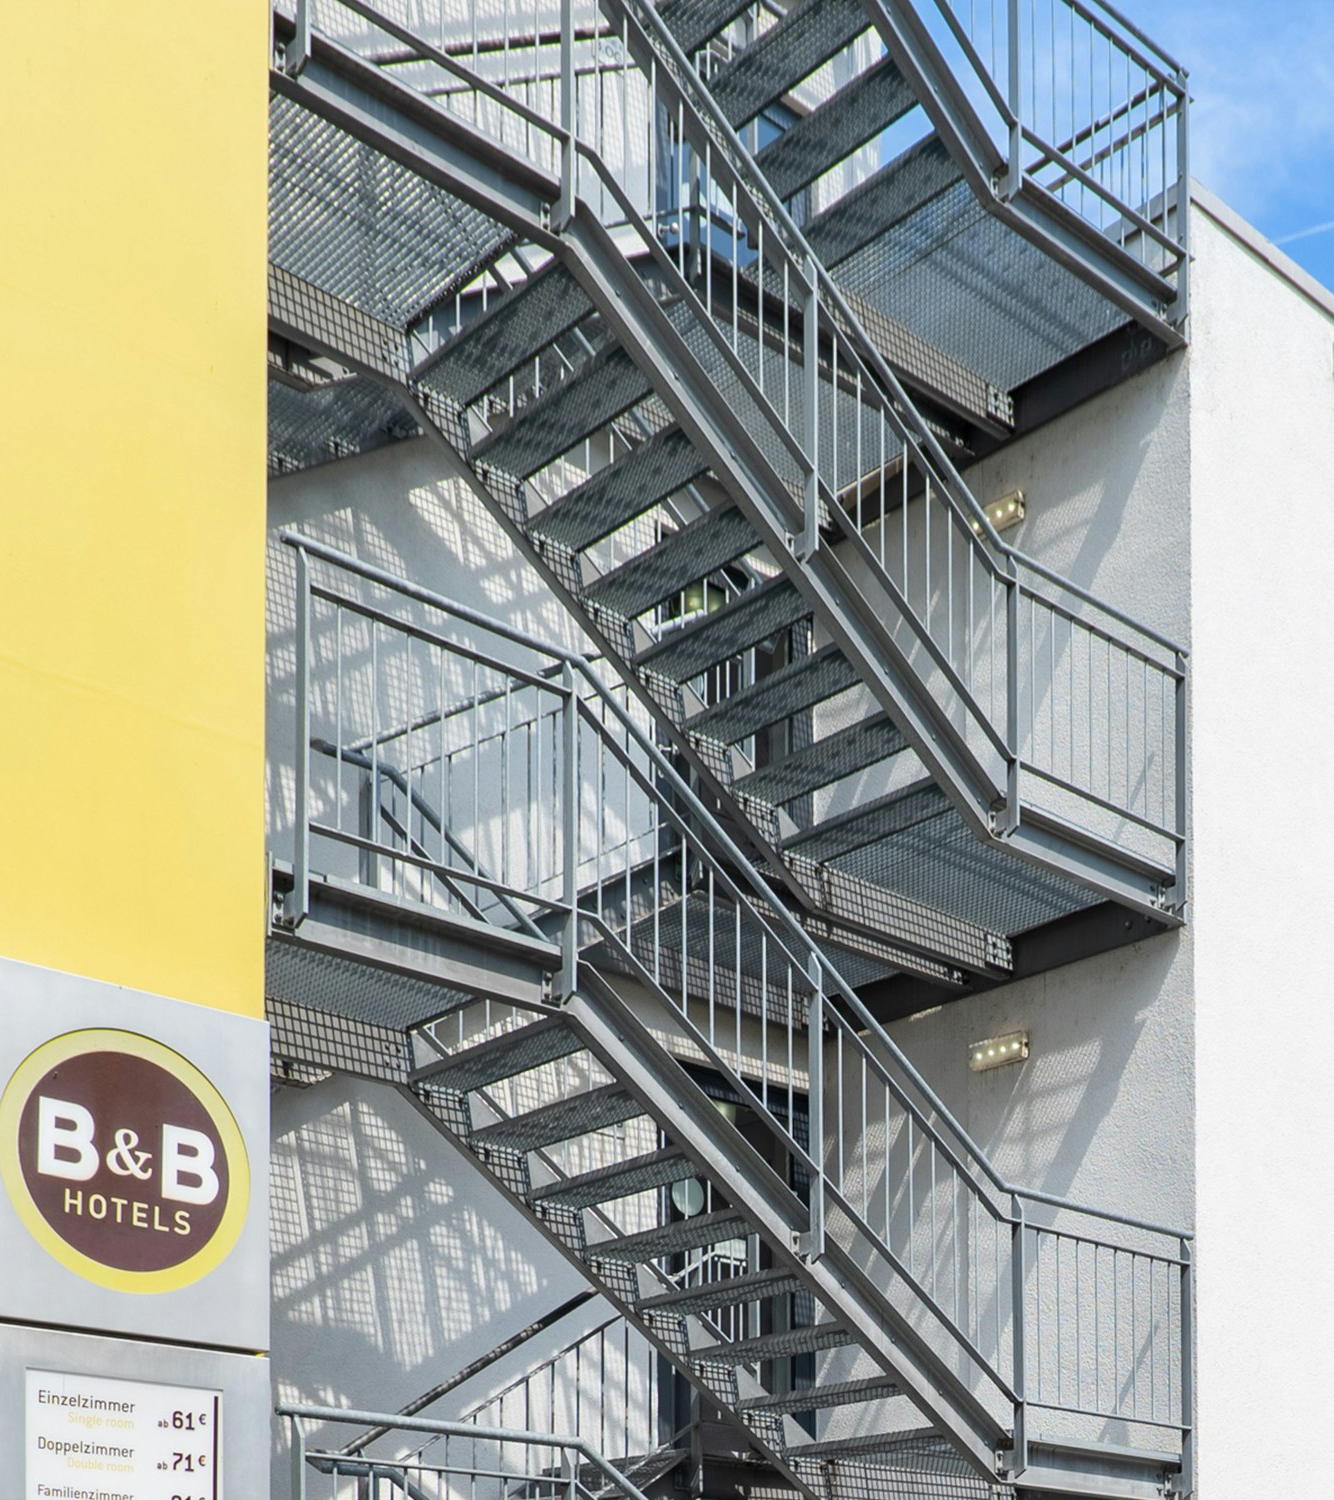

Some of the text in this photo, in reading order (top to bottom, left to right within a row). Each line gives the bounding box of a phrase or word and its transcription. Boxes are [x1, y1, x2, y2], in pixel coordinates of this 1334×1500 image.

[37, 1095, 219, 1206] B&B
[64, 1188, 191, 1236] HOTELS
[38, 1389, 135, 1413] Einzelzimmer
[68, 1411, 134, 1429] Single room
[157, 1419, 169, 1428] ab
[172, 1410, 195, 1431] 61
[38, 1436, 134, 1458] Doppelzimmer
[67, 1456, 134, 1473] Double room
[157, 1461, 168, 1470] ab
[172, 1452, 195, 1472] 71
